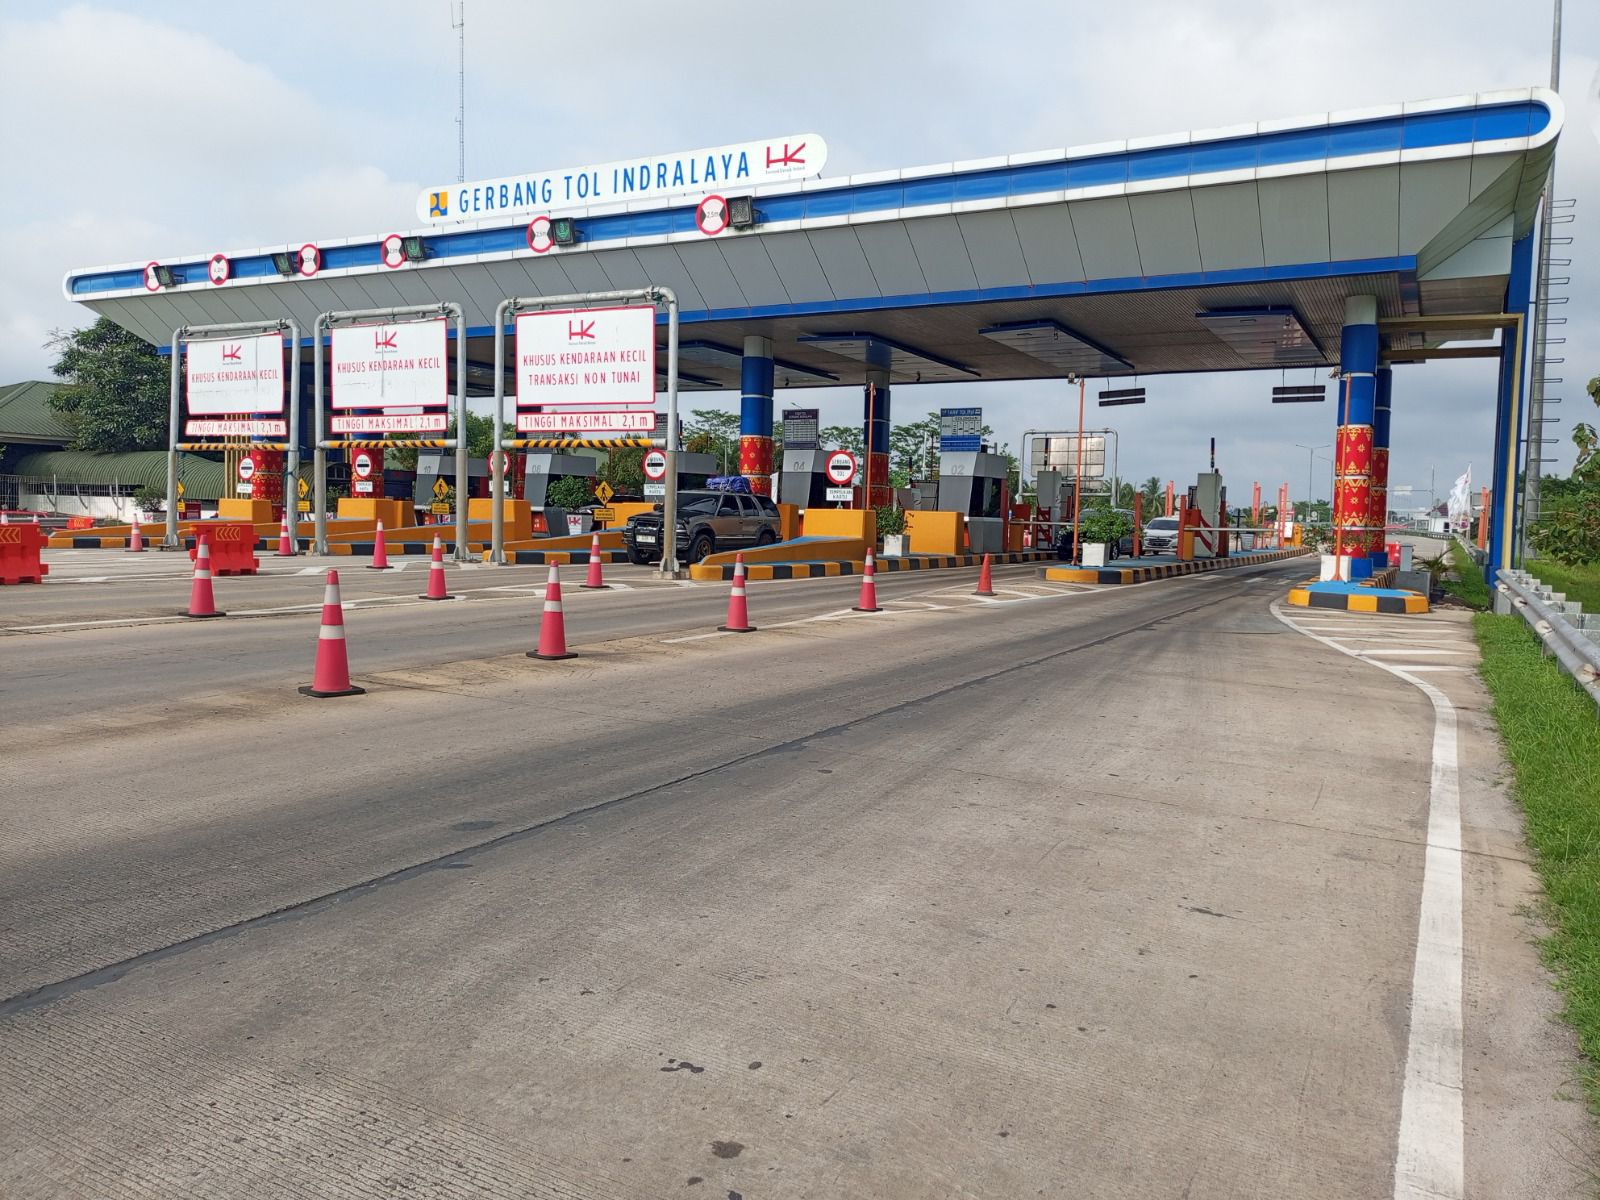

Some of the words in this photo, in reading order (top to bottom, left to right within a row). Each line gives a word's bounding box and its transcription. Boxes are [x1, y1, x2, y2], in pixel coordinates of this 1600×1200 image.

[458, 178, 552, 214] GERBANG
[564, 172, 601, 200] TOL
[613, 151, 750, 194] INDRALAYA
[523, 353, 556, 366] KHUSUS
[559, 351, 616, 365] KENDARAAN
[620, 349, 647, 363] KECIL
[337, 361, 366, 374] KHUSUS
[368, 359, 414, 372] KENDARAAN
[418, 357, 441, 369] KECIL
[191, 371, 215, 383] KHUSUS
[217, 370, 257, 382] KENDARAAN
[259, 369, 279, 380] KECIL
[528, 373, 579, 386] TRANSAKSI
[584, 372, 606, 384] NON
[612, 371, 640, 384] TUNAI
[191, 421, 215, 434] TINGGI
[217, 421, 256, 433] MAKSIMAL
[274, 423, 282, 432] m
[337, 418, 364, 430] TINGGI
[368, 417, 415, 430] MAKSIMAL
[419, 417, 431, 429] 2,1
[433, 418, 441, 428] m
[524, 416, 556, 428] TINGGI
[561, 415, 613, 428] MAKSIMAL
[622, 415, 635, 429] 2,1
[639, 418, 648, 427] m
[793, 461, 805, 471] 04
[951, 464, 965, 475] 02
